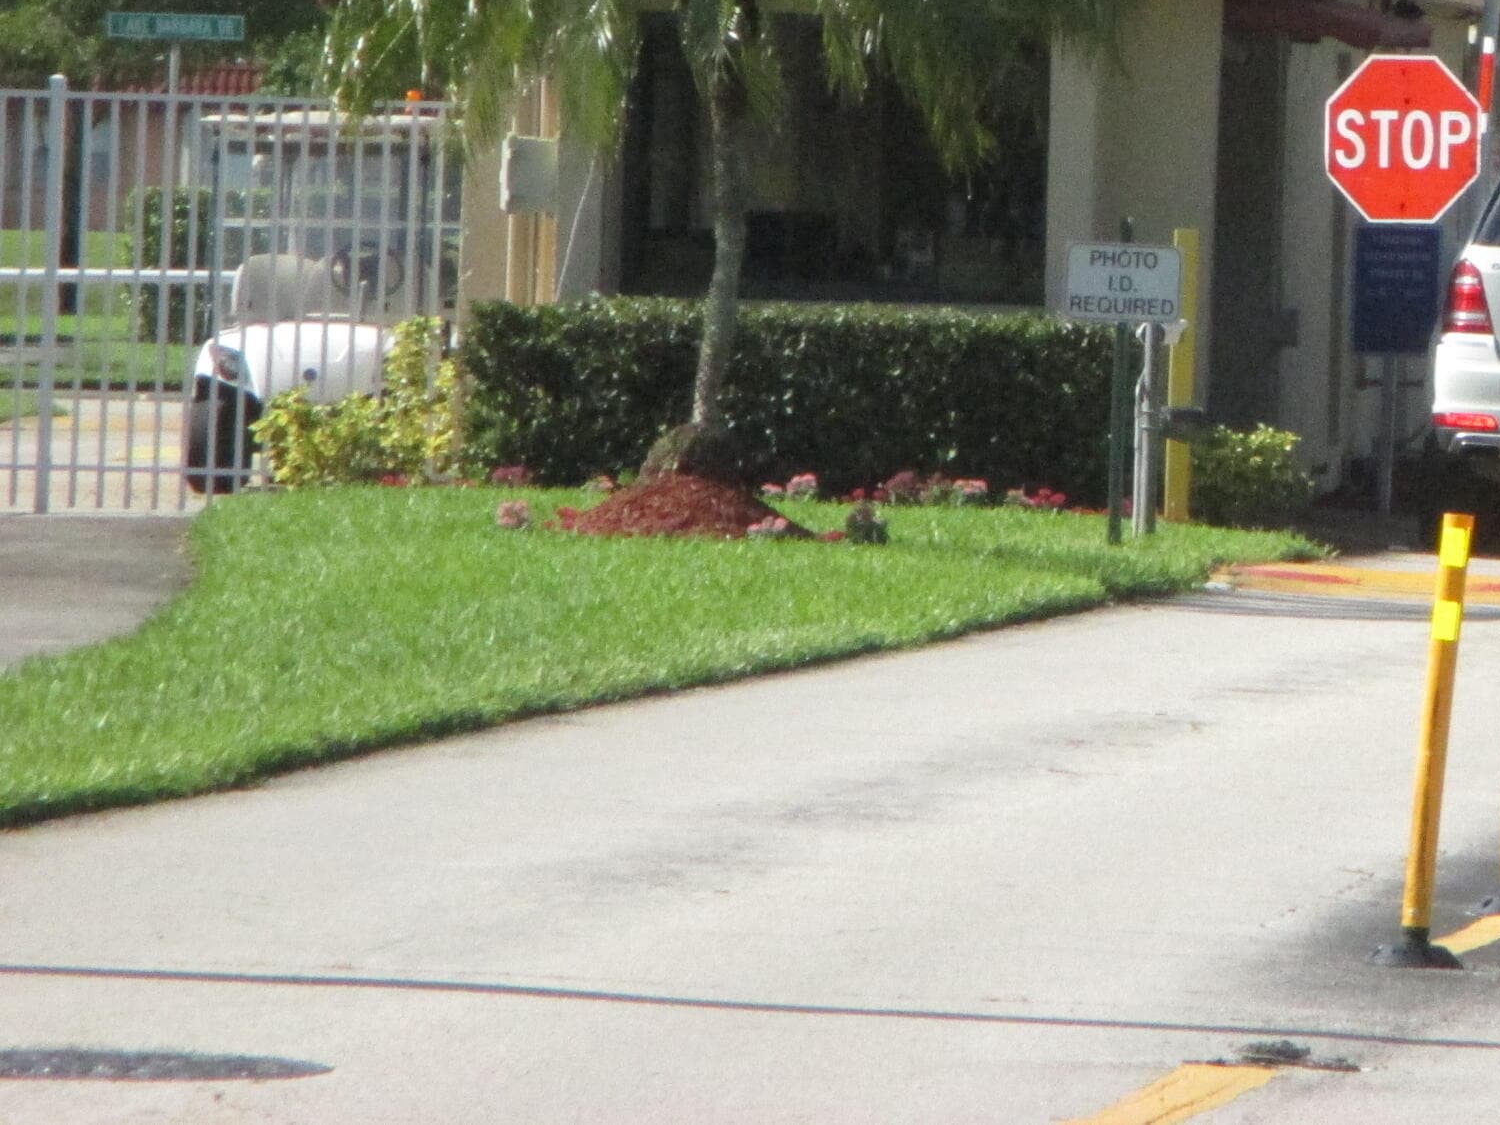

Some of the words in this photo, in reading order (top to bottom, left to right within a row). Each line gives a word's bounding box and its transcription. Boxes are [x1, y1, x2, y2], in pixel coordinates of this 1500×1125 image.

[1335, 108, 1471, 170] STOP
[1089, 250, 1158, 269] PHOTO
[1108, 275, 1138, 292] I.D.
[1069, 296, 1174, 316] REQUIRED
